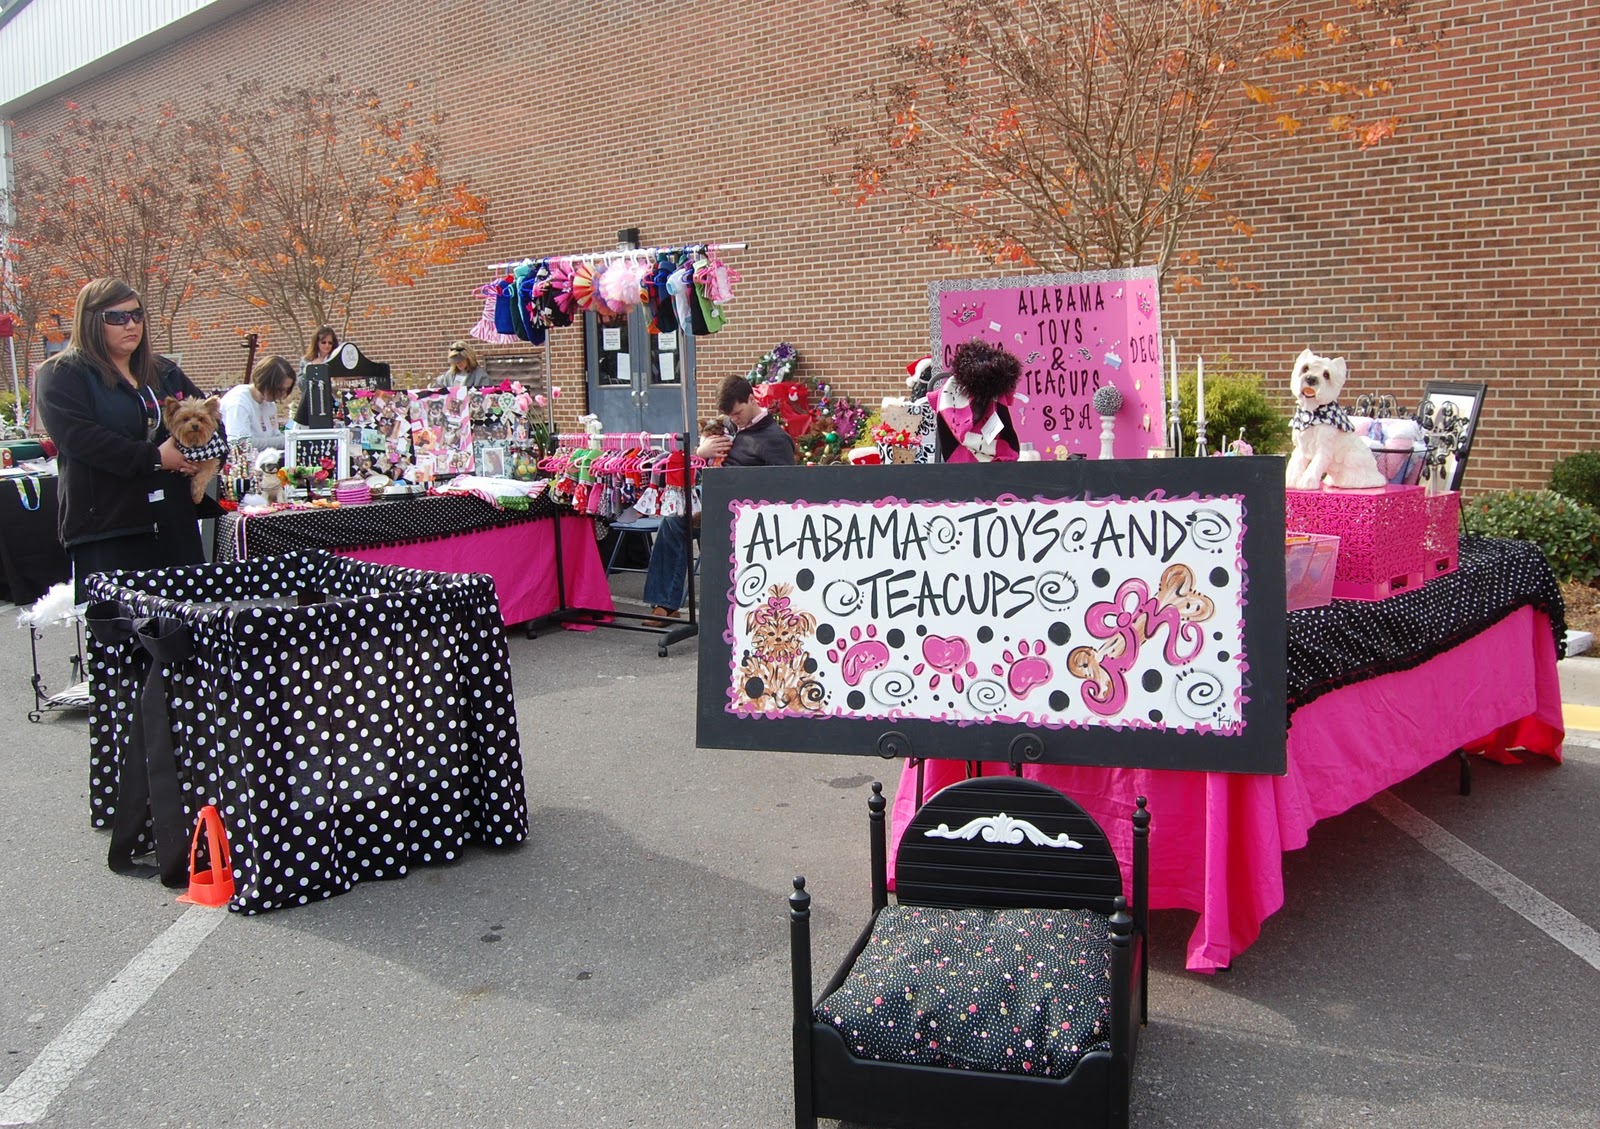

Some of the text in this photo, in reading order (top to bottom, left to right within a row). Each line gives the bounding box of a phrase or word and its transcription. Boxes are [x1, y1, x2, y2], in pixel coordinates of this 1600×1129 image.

[1018, 285, 1105, 316] ALABAMA
[1037, 318, 1083, 346] TOYS
[1051, 347, 1067, 372] &
[1025, 369, 1101, 398] TEACUPS
[1042, 403, 1093, 431] SPA
[743, 509, 1187, 564] ALABAMA TOYS AND
[857, 568, 1037, 620] TEACUPS
